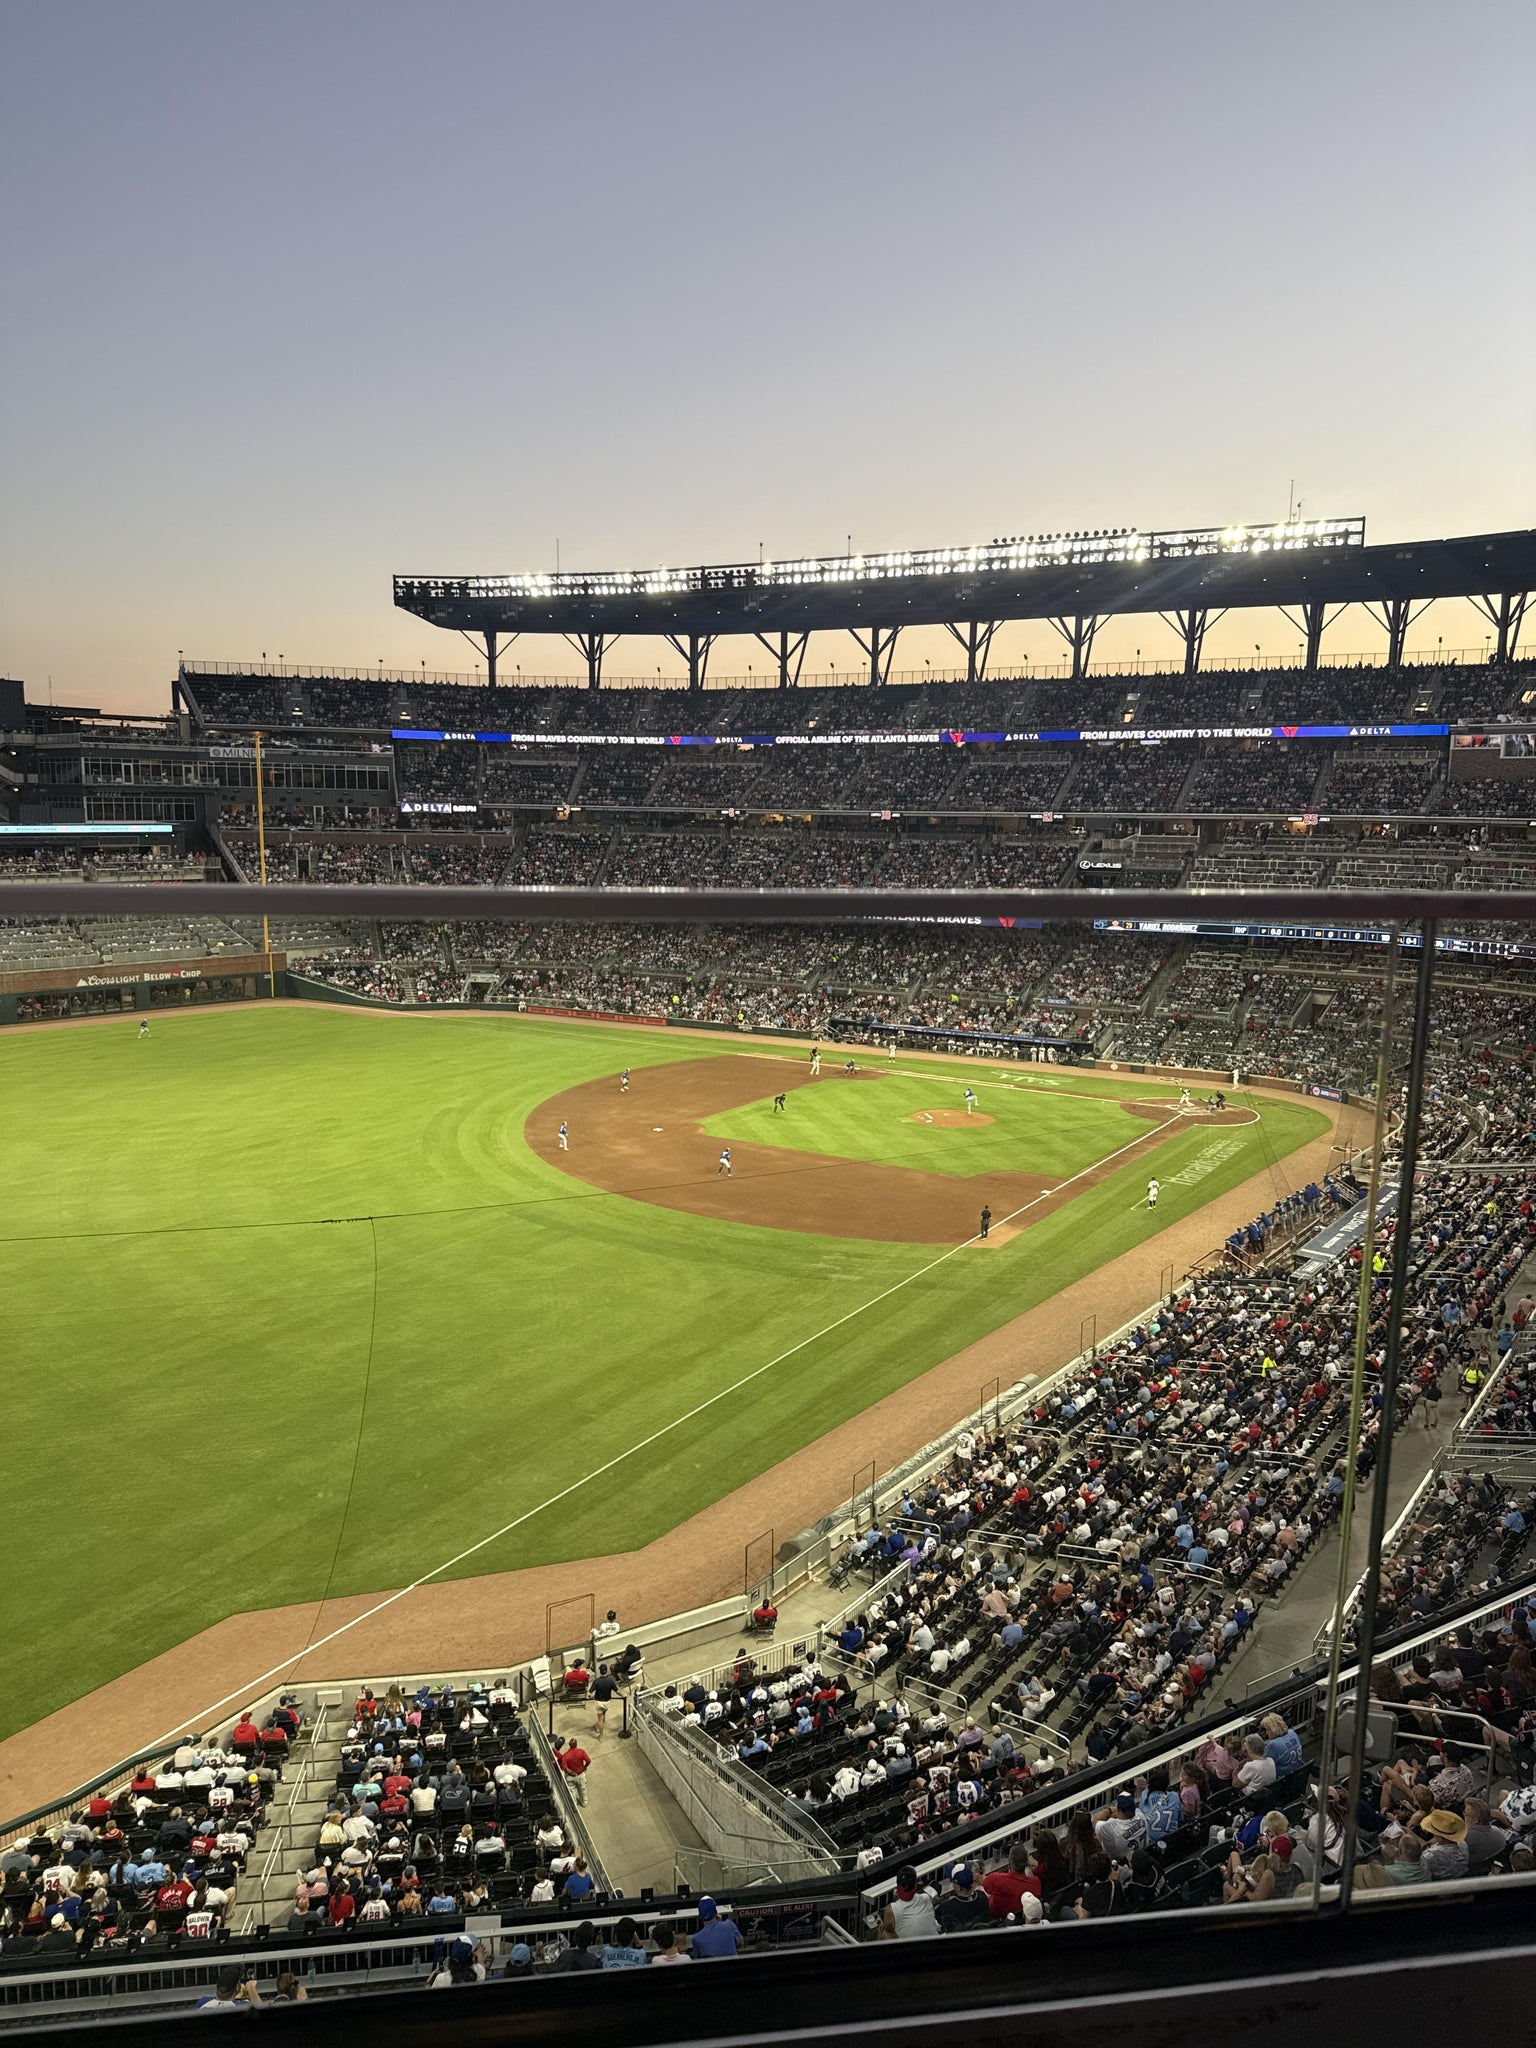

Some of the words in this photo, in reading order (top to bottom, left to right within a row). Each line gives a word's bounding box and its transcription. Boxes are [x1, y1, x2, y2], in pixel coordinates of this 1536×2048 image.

[1080, 731, 1108, 740] FROM
[1109, 730, 1146, 740] BRAVES
[1147, 729, 1196, 739] COUNTRY
[1197, 729, 1212, 738] TO
[1212, 729, 1232, 738] THE
[1233, 728, 1272, 737] WORLD
[1360, 727, 1391, 735] DELTA
[535, 735, 567, 743] BRAVES
[567, 735, 606, 744] COUNTRY
[606, 736, 619, 744] TO
[619, 736, 635, 744] THE
[635, 736, 665, 745] WORLD
[776, 736, 811, 744] OFFICIAL
[811, 736, 841, 744] AIRLINE
[842, 736, 853, 744] OF
[870, 735, 906, 743] ATLANTA
[907, 734, 940, 743] BRAVES
[414, 803, 450, 812] DELTA
[1303, 813, 1319, 825] 25
[1234, 926, 1247, 934] RHP
[143, 972, 172, 982] BELOW
[180, 970, 202, 979] CHOP
[851, 1777, 855, 1788] 1
[960, 1791, 974, 1802] 44
[1151, 1810, 1173, 1831] 27
[46, 1878, 60, 1891] 34
[739, 1907, 774, 1916] CAUTION
[793, 1903, 814, 1911] ALERT
[189, 1915, 209, 1924] BALDWIN
[189, 1923, 208, 1937] 30
